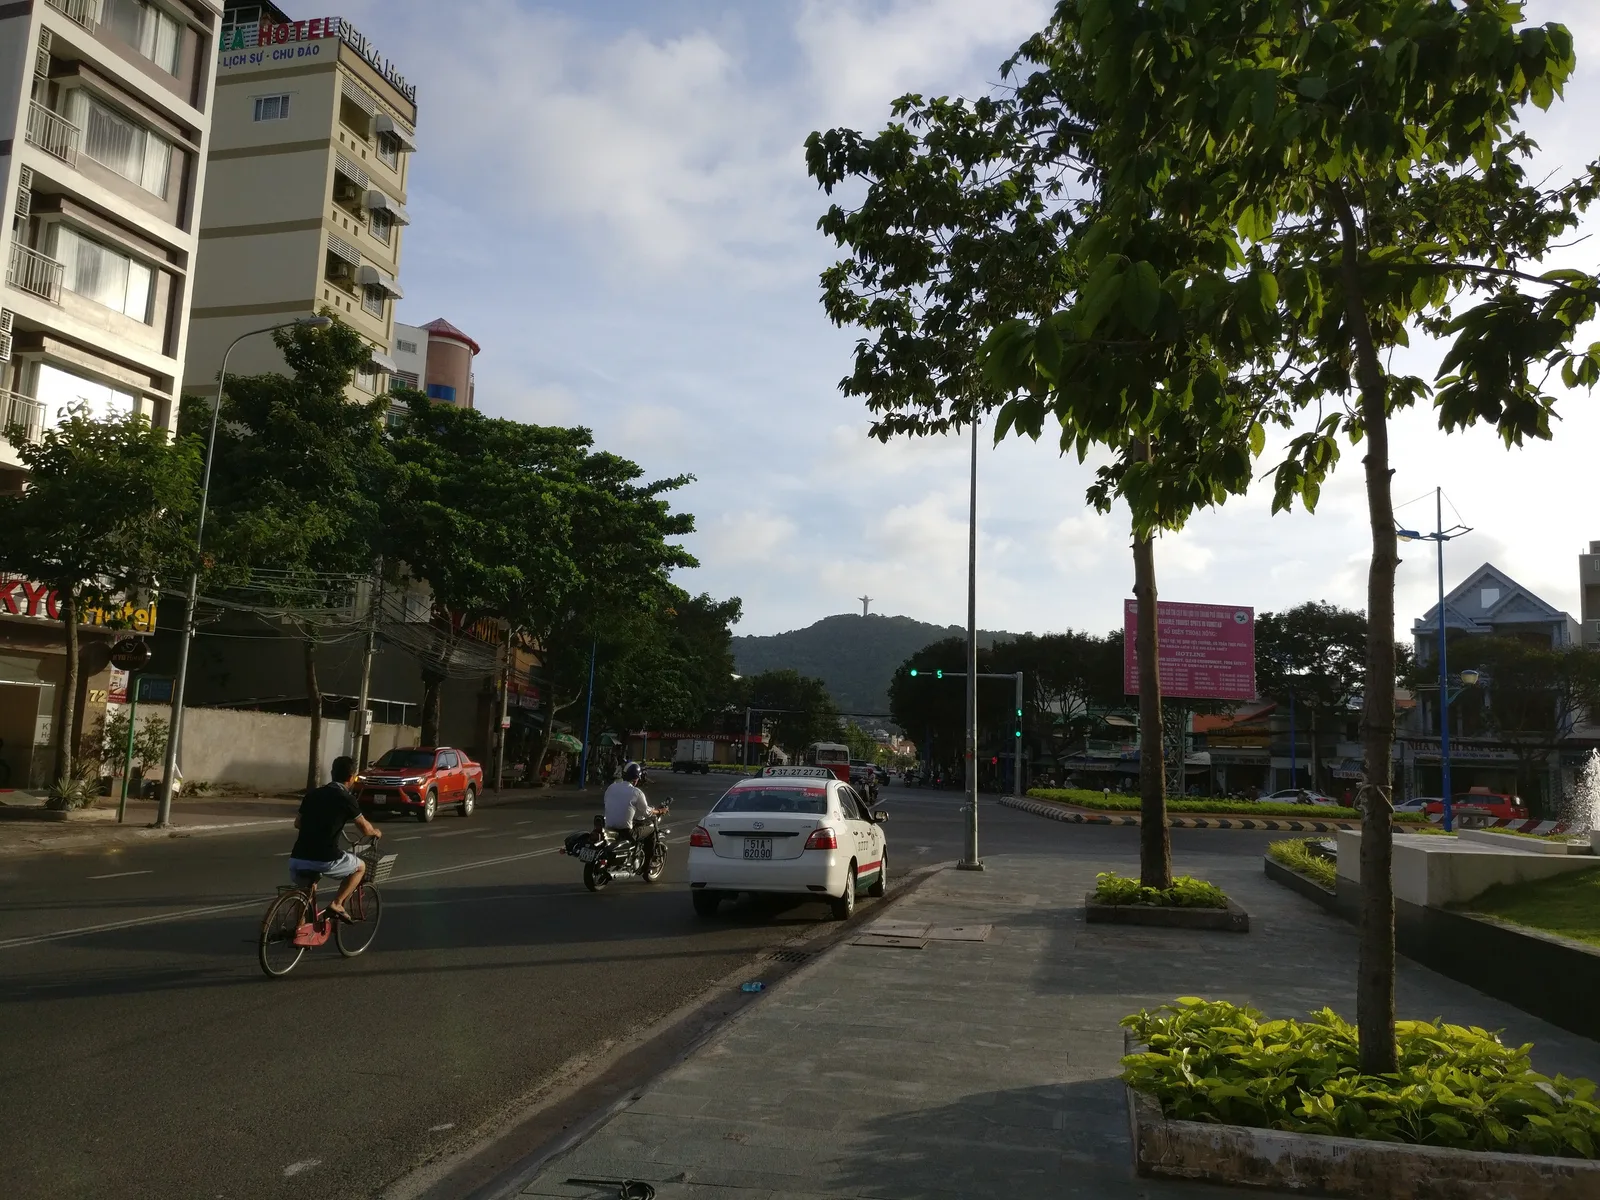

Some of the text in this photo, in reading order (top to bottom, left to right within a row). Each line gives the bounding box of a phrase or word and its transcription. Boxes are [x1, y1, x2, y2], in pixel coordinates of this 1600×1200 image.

[258, 16, 335, 47] HOTEL
[338, 16, 383, 74] SEIKA
[223, 43, 320, 70] LỊCH SỰ CHU ĐÁO
[89, 689, 107, 702] 72
[803, 768, 814, 776] 27
[816, 768, 826, 776] 27
[750, 840, 765, 848] 51A
